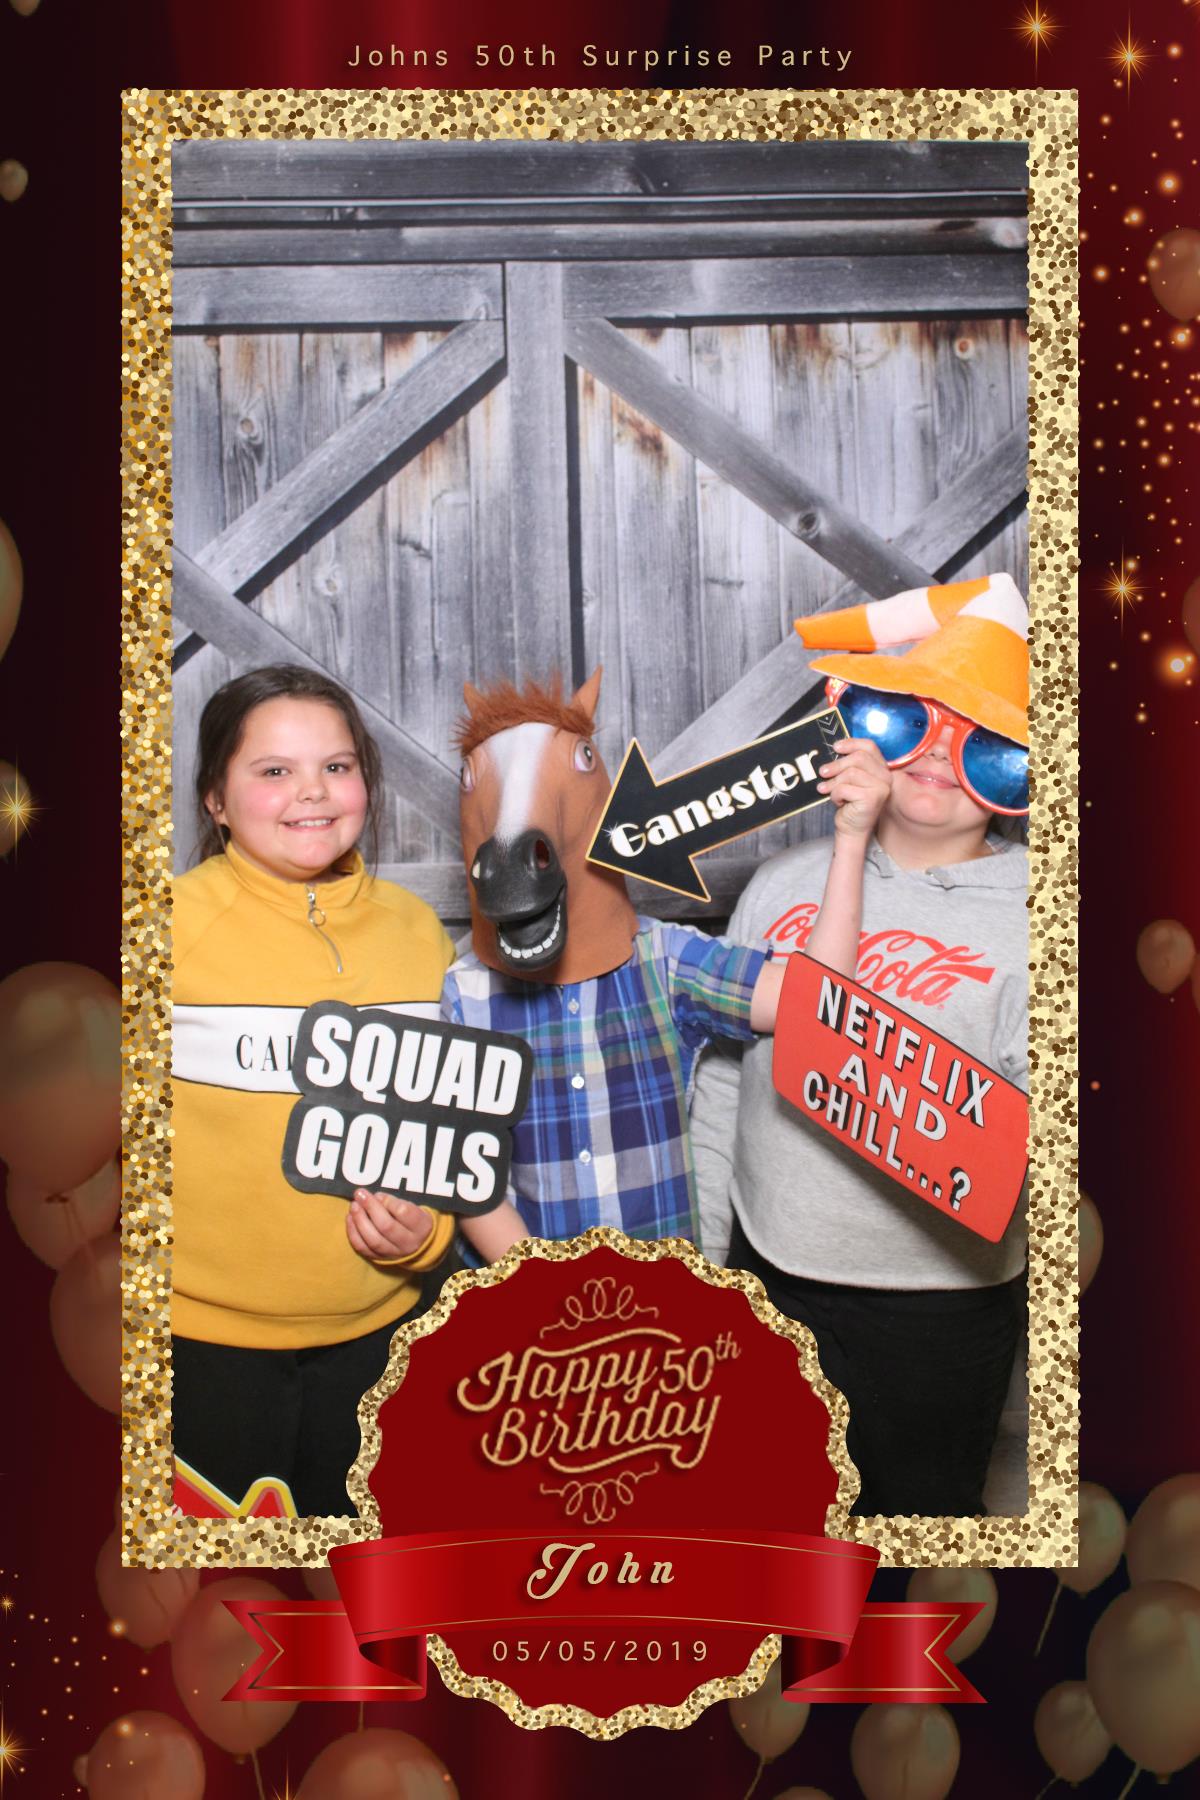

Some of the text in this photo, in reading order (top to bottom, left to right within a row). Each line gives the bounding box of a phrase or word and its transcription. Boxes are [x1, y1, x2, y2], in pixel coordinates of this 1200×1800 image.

[610, 748, 819, 858] Gangster
[305, 1014, 523, 1116] SQUAD
[816, 975, 995, 1128] NETFLIX
[837, 1052, 948, 1142] AND
[295, 1105, 501, 1204] GOALS
